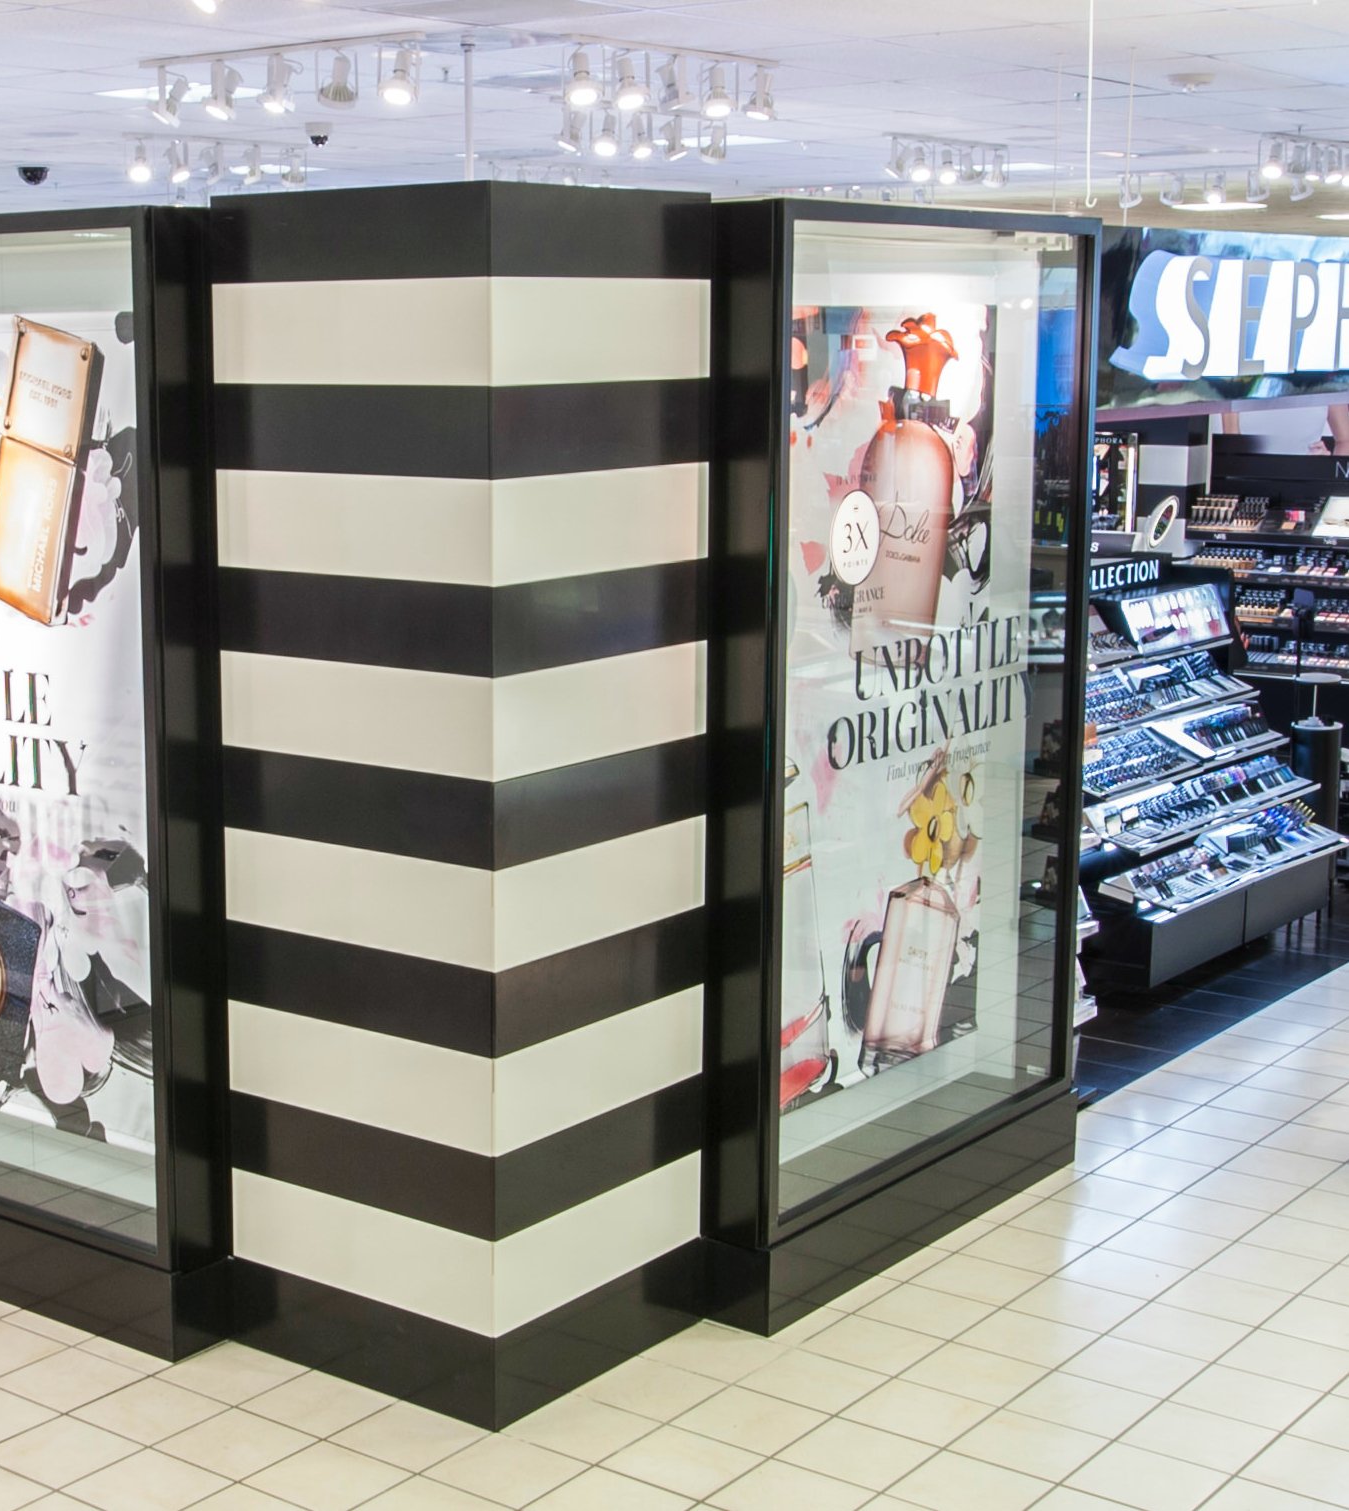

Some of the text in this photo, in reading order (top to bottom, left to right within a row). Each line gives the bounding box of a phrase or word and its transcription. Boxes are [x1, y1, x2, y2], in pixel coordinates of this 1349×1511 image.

[842, 521, 869, 553] 3X
[1091, 559, 1160, 591] LLECTION
[854, 616, 1021, 701] UNBOTTLE
[827, 671, 1034, 770] ORIGINALITY
